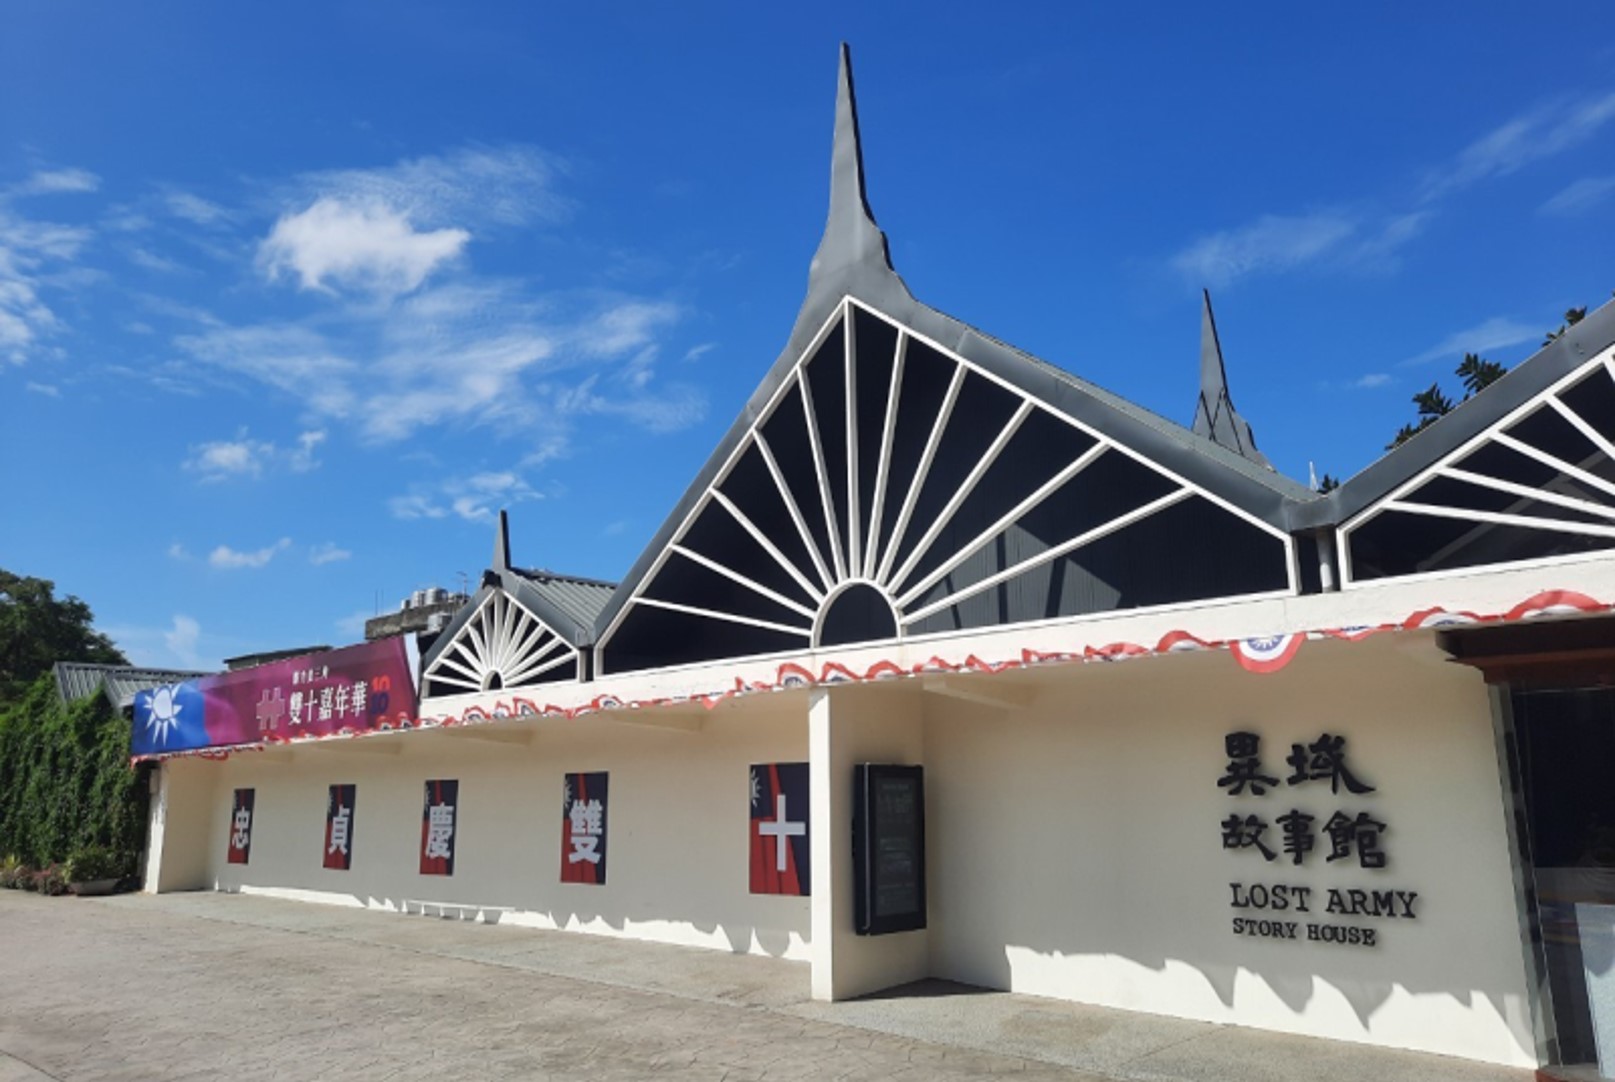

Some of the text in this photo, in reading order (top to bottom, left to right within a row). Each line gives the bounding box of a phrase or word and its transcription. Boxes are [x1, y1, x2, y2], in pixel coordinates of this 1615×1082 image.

[288, 680, 368, 726] 雙十嘉年華
[1217, 731, 1376, 795] 異域
[232, 806, 250, 849] 忠
[328, 804, 350, 854] 貞
[425, 802, 454, 858] 慶
[568, 799, 602, 864] 雙
[758, 794, 806, 872] 十
[1221, 809, 1387, 868] 故事館
[1229, 882, 1417, 918] LOST ARMY
[1233, 918, 1376, 946] STORY HOUSE
